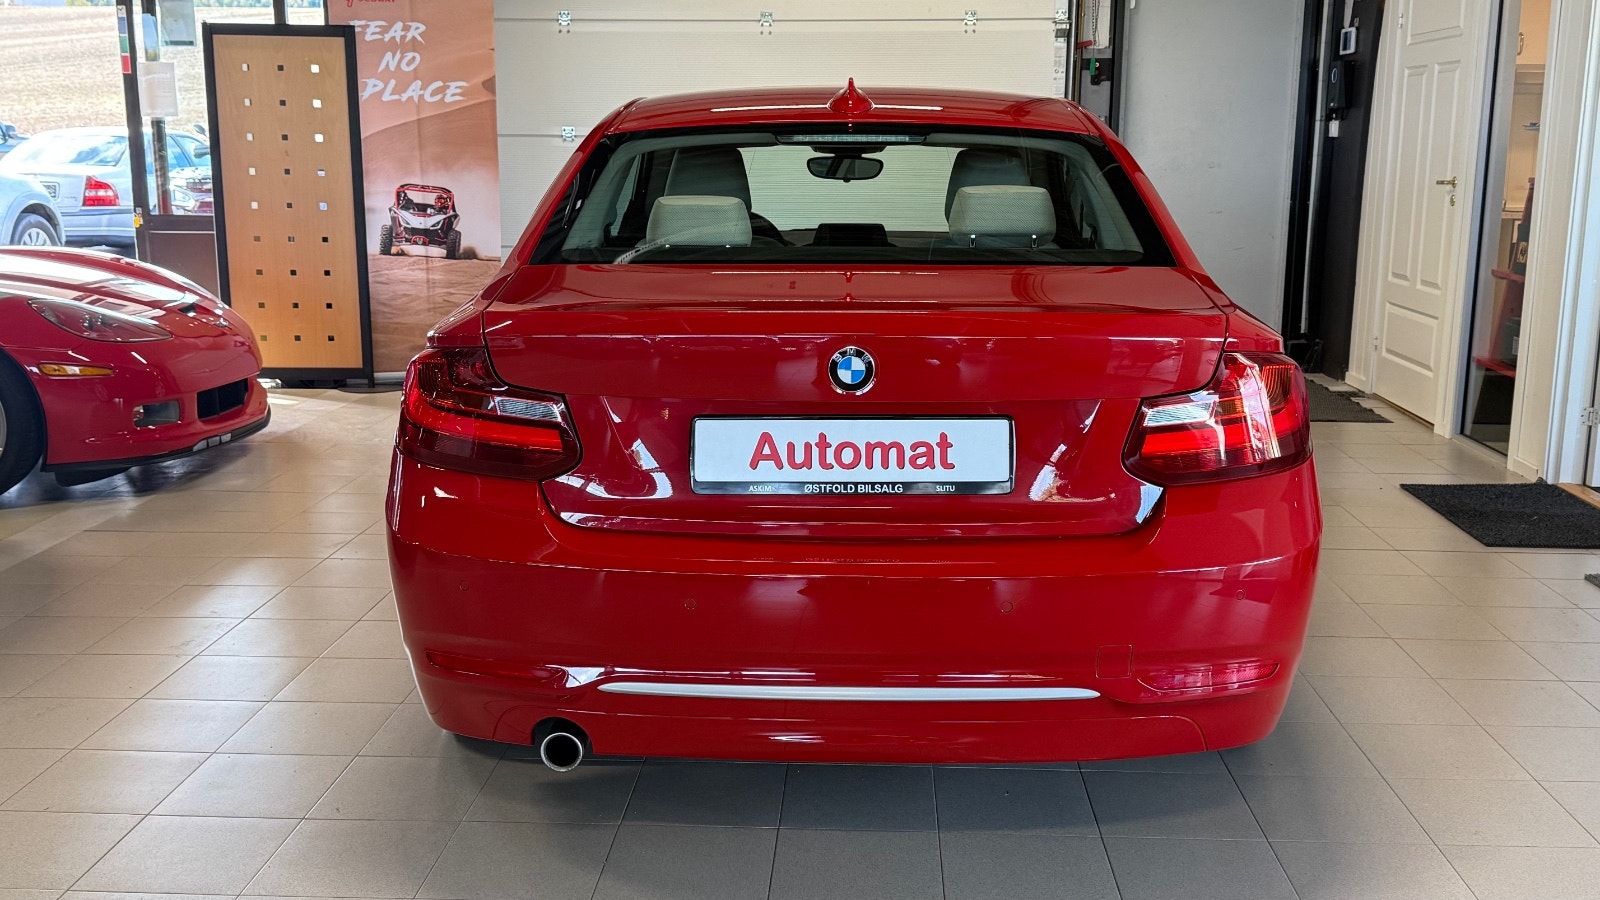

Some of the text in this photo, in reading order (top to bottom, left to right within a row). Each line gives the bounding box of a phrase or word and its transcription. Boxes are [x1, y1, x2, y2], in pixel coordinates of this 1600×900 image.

[350, 20, 426, 44] FEAR
[378, 49, 421, 73] NO
[360, 78, 469, 104] PLACE
[749, 431, 956, 470] Automat
[804, 484, 903, 493] ØSTFOLD BILSALG
